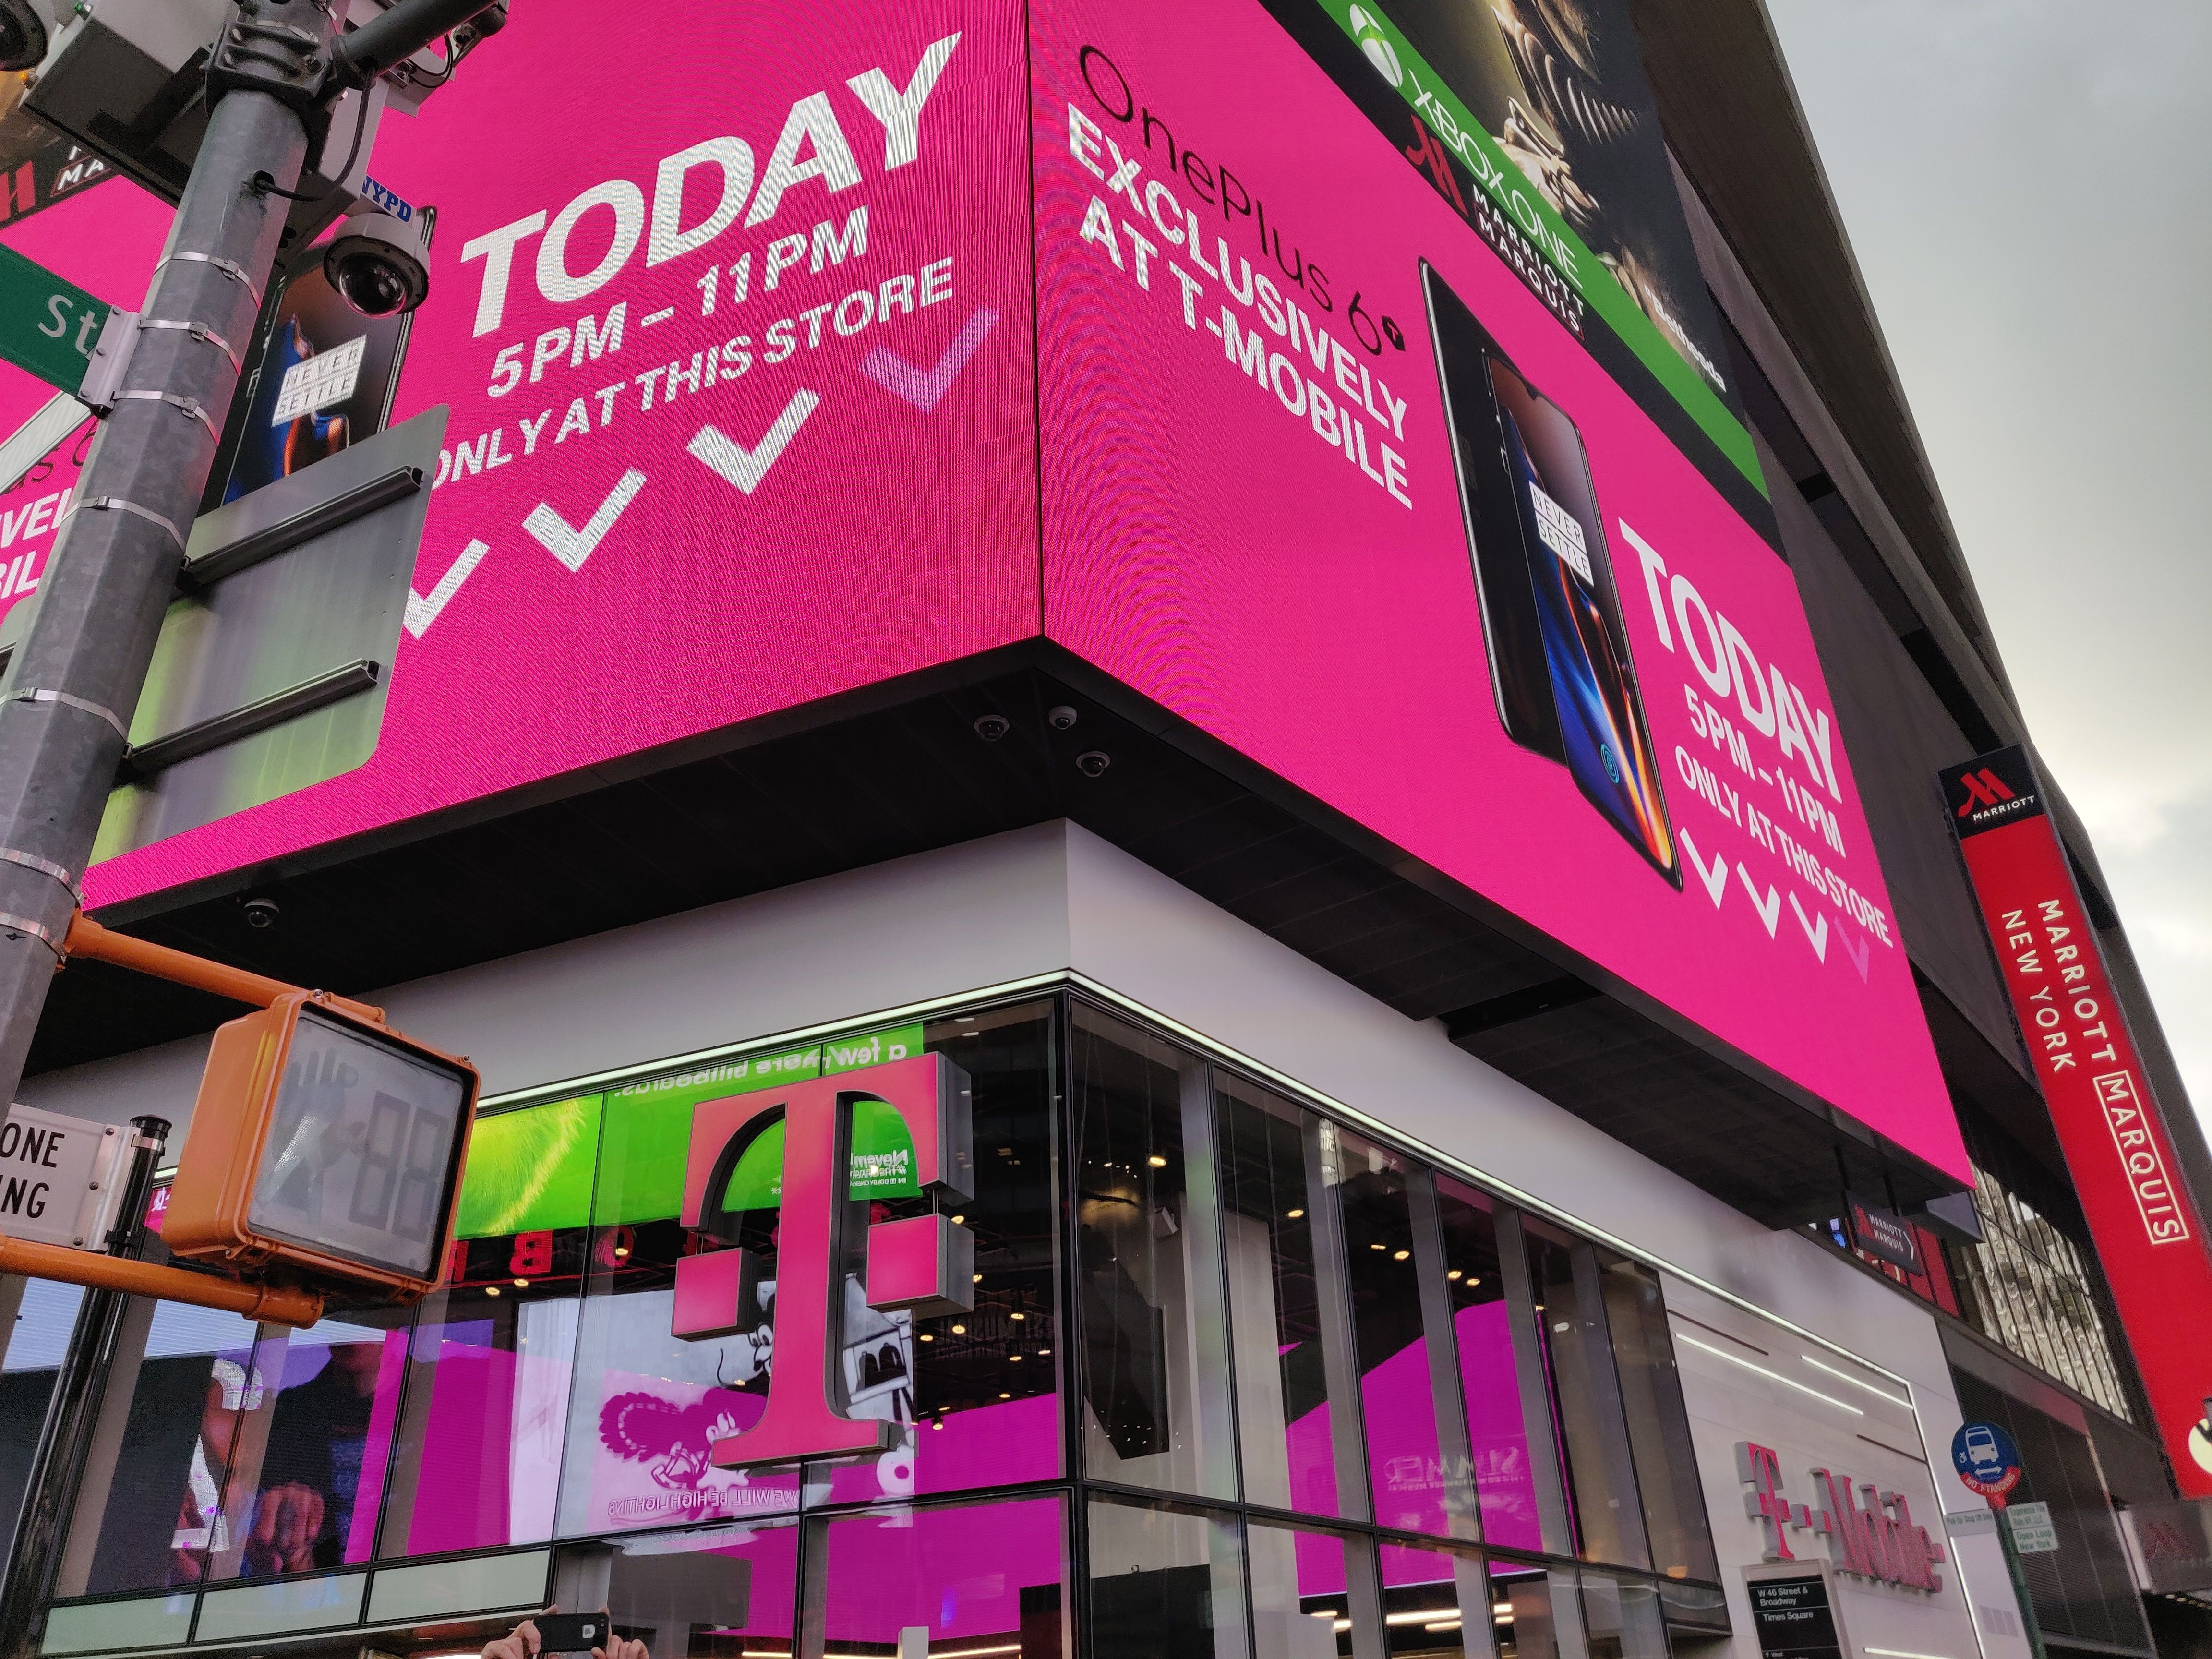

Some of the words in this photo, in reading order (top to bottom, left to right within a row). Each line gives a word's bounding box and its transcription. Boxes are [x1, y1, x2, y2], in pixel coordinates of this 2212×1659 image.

[362, 175, 412, 222] NYPD
[459, 31, 962, 338] TODAY
[1080, 45, 1332, 312] OnePlus
[1408, 68, 1513, 211] XBOX
[1511, 189, 1583, 289] ONE
[487, 301, 627, 398] 5PM
[697, 204, 868, 316] 11PM
[1068, 101, 1407, 442] EXCLUSIVELY
[1473, 184, 1583, 316] MARRIOTT
[1479, 212, 1580, 333] MARQUIS
[37, 294, 98, 354] St
[433, 409, 552, 490] ONLY
[555, 382, 625, 444] AT
[636, 335, 753, 412] THIS
[763, 256, 953, 364] STORE
[1080, 195, 1158, 291] AT
[1169, 260, 1412, 510] T-MOBILE
[1651, 293, 1727, 392] Bethesda
[1533, 488, 1582, 545] NEVER
[1539, 519, 1589, 577] SETTLE
[1618, 517, 1842, 804] TODAY
[1684, 683, 1755, 781] 5PM
[1776, 766, 1846, 858] 11PM
[1972, 795, 2034, 821] MARRIOTT
[1675, 745, 1742, 828] ONLY
[1747, 802, 1775, 854] AT
[1775, 825, 1827, 895] THIS
[1825, 867, 1893, 948] STORE
[2001, 909, 2043, 974] NEW
[2028, 986, 2077, 1073] YORK
[2038, 899, 2117, 1063] MARRIOTT
[2100, 1077, 2182, 1238] MARQUIS
[0, 1122, 65, 1168] ONE
[1869, 1214, 1902, 1238] MARRIOTT
[1874, 1229, 1903, 1252] MARQUIS
[1966, 1476, 1977, 1488] NO
[1981, 1472, 2015, 1493] STANDING
[1760, 1598, 1796, 1607] Broadway
[1778, 1587, 1801, 1595] Street
[1787, 1611, 1814, 1620] Square
